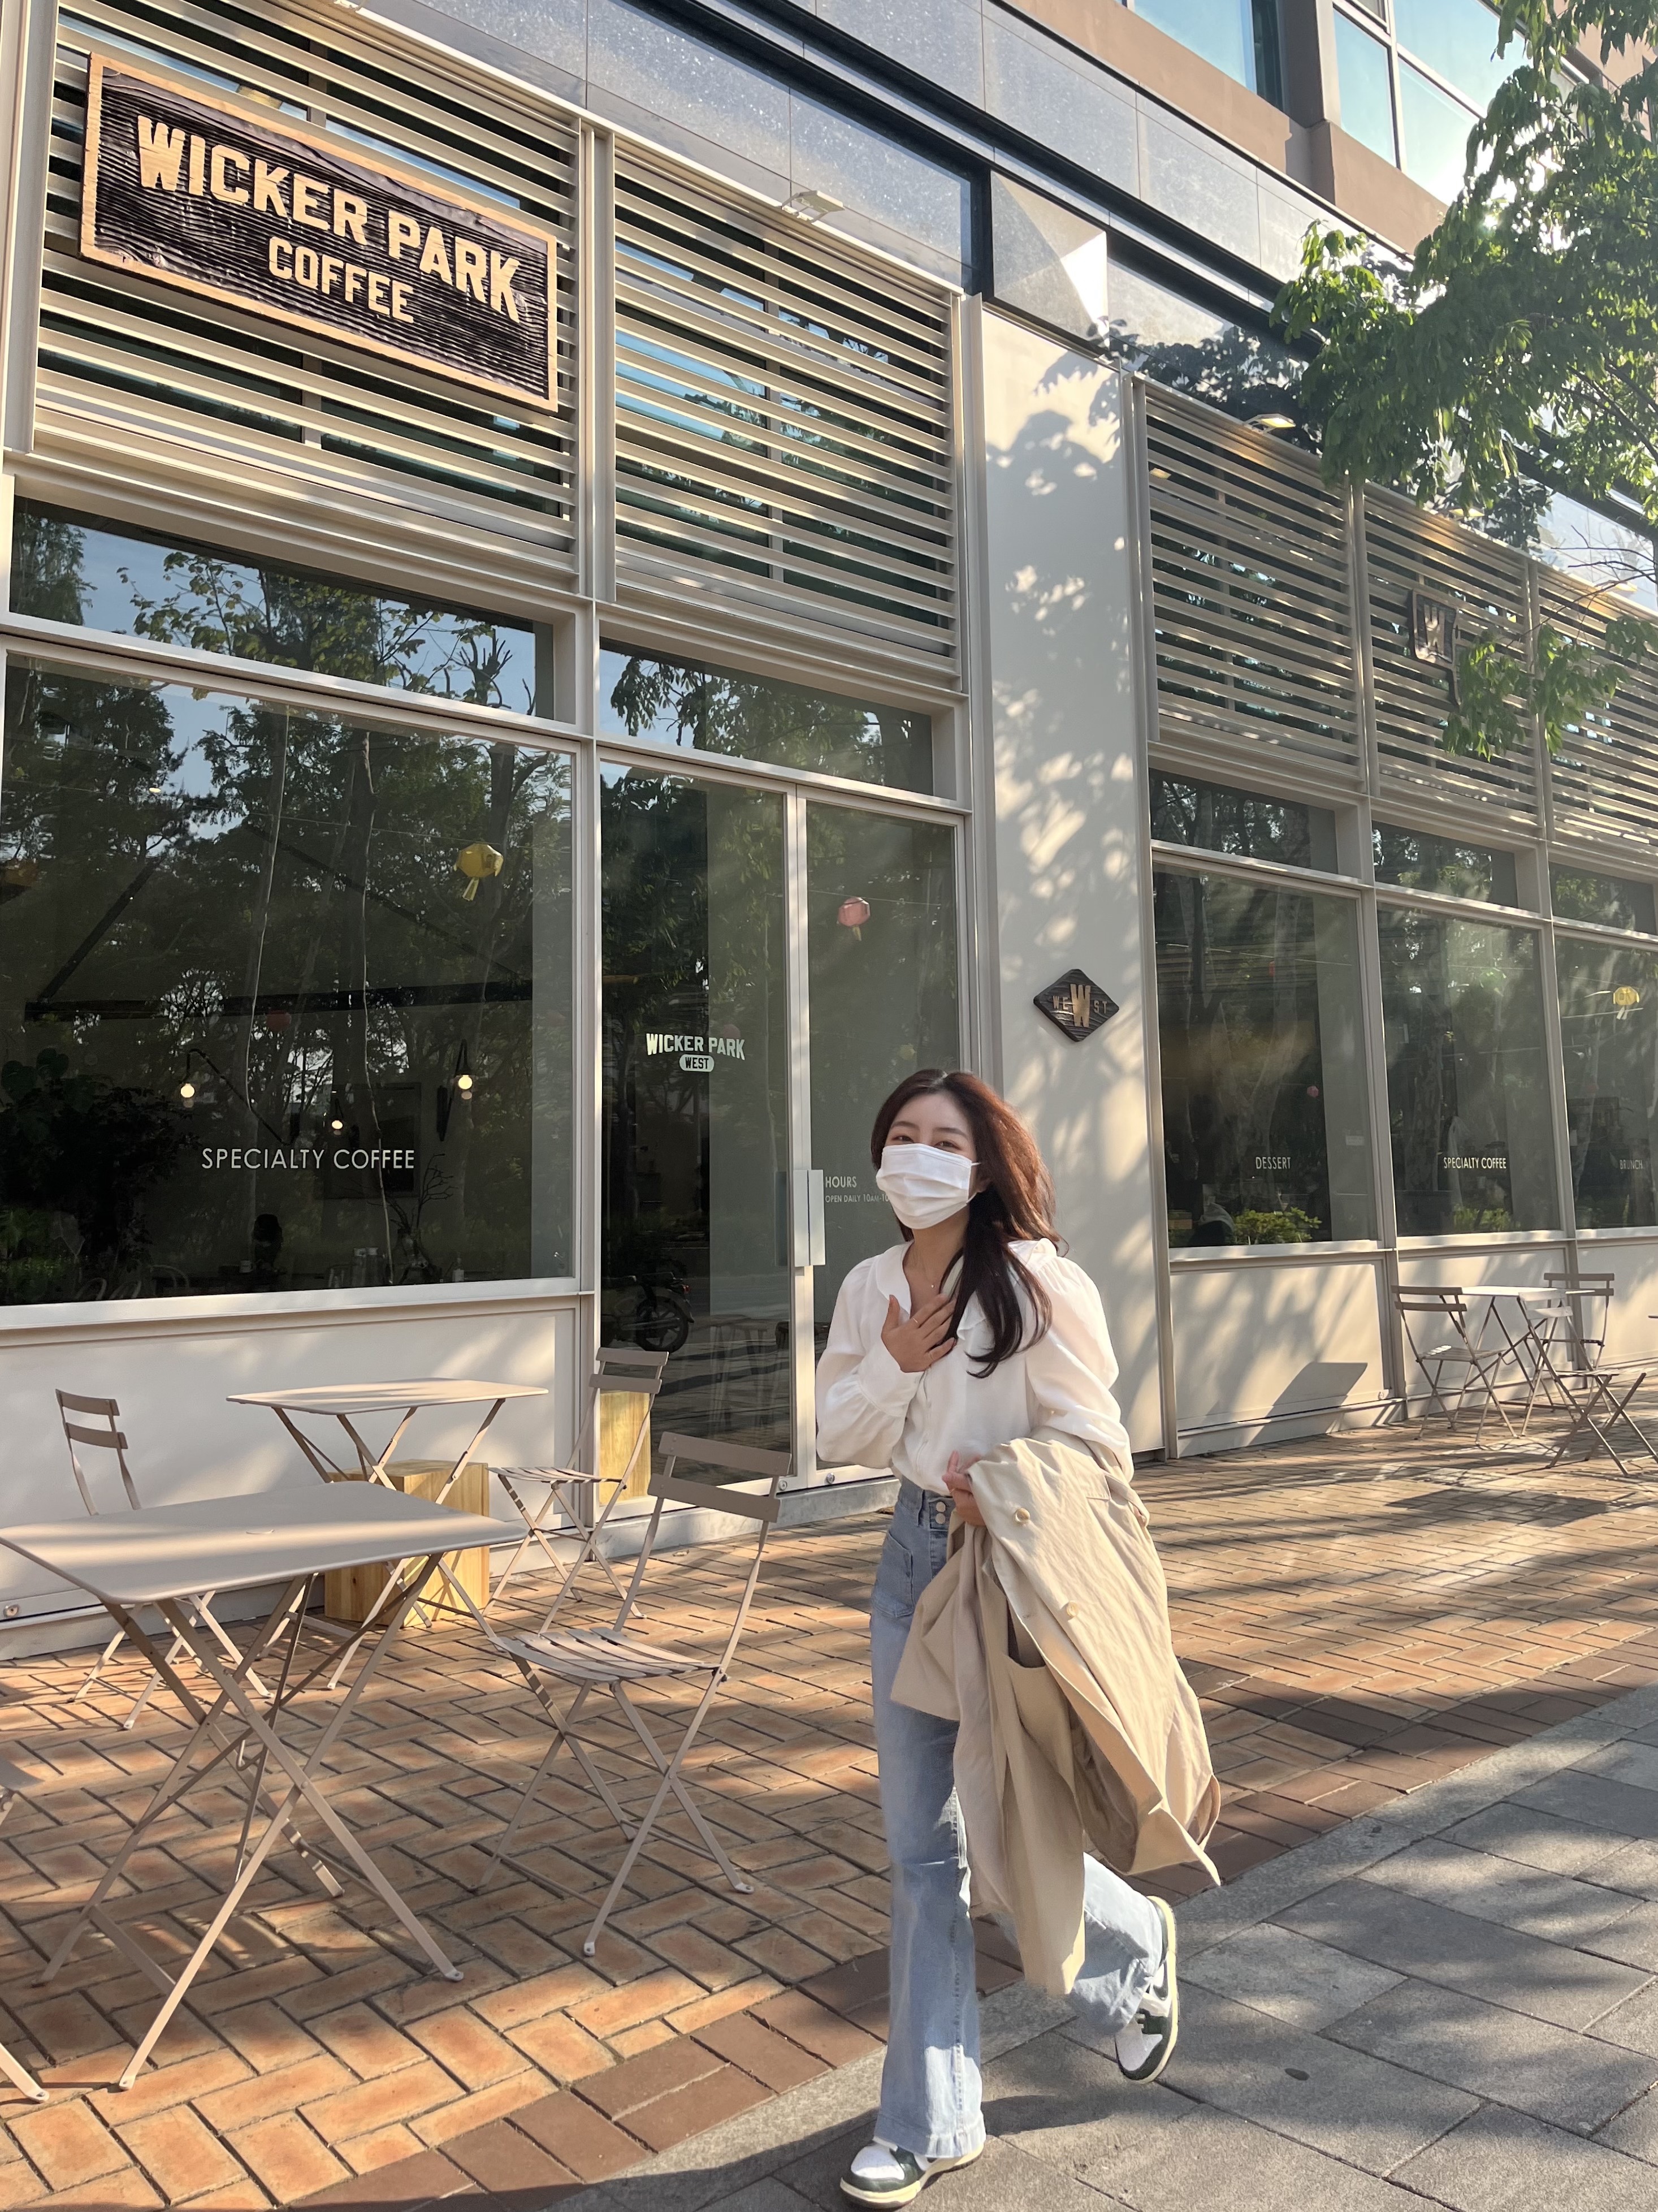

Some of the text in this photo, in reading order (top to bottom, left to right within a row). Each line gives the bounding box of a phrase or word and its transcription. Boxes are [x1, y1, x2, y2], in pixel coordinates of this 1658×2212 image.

[137, 115, 521, 324] WICKER PARK
[269, 236, 414, 324] COFFEE
[646, 1033, 745, 1060] WICKER PARK
[685, 1057, 709, 1069] WEST
[201, 1148, 415, 1169] SPECIALTY COFFEE
[1256, 1156, 1291, 1169] DESSERT
[1443, 1157, 1507, 1169] SPECIALTY COFFEE
[1620, 1159, 1643, 1170] BRUNCH
[825, 1176, 857, 1187] HOURS
